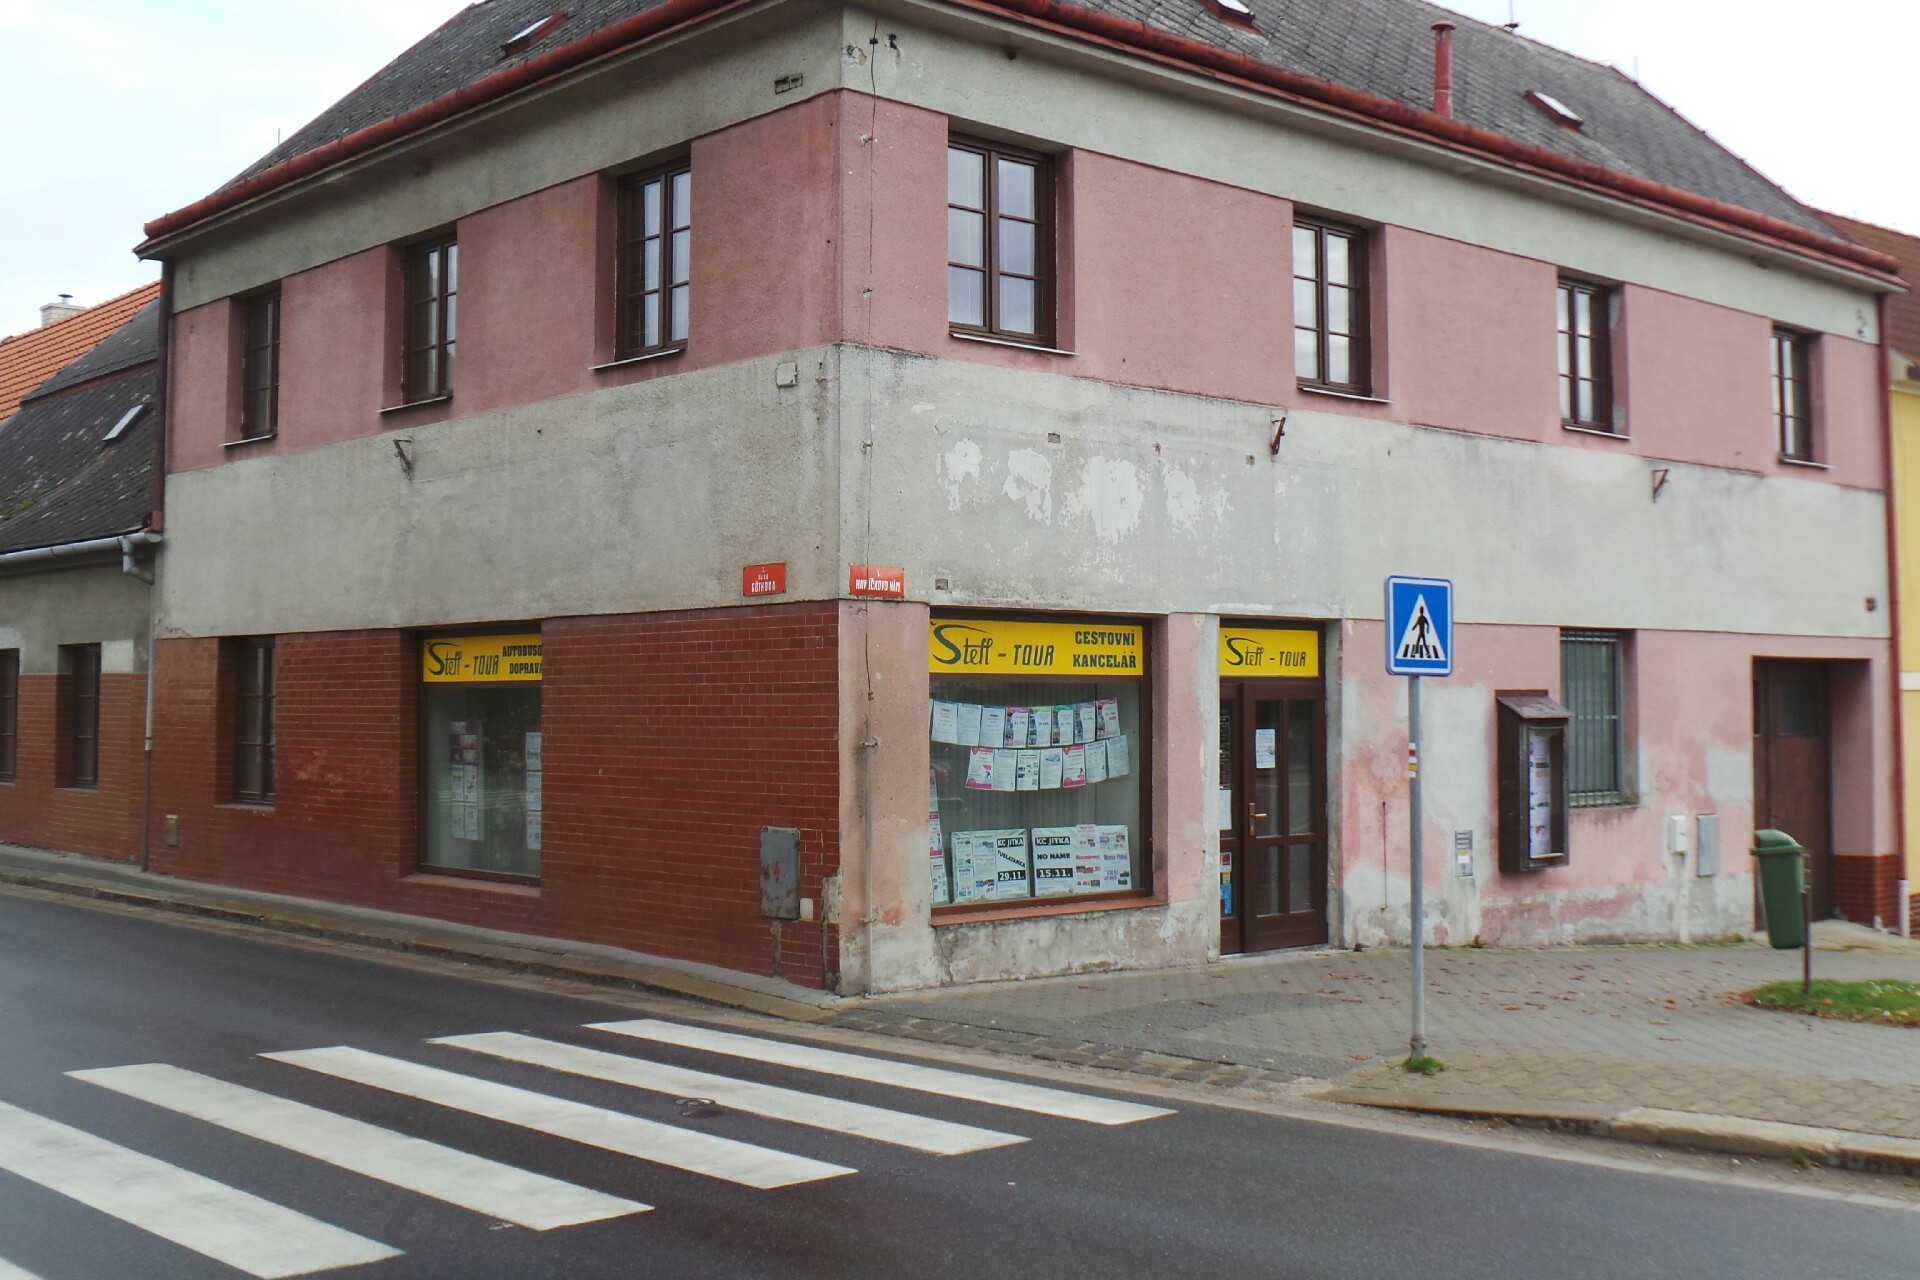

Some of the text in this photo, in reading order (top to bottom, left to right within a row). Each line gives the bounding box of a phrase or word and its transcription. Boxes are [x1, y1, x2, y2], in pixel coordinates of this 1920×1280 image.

[855, 577, 889, 592] HAVÍČKOVO
[1074, 629, 1135, 646] CESTOVNÍ
[1013, 644, 1055, 667] TOUR
[1072, 651, 1137, 668] KANCELÁŘ
[1279, 651, 1307, 667] TOUR
[473, 655, 499, 675] TOUR
[997, 838, 1024, 847] KC JITKA
[1048, 836, 1070, 846] JITKA
[999, 871, 1025, 881] 29.11.
[1039, 869, 1070, 878] 15.11.
